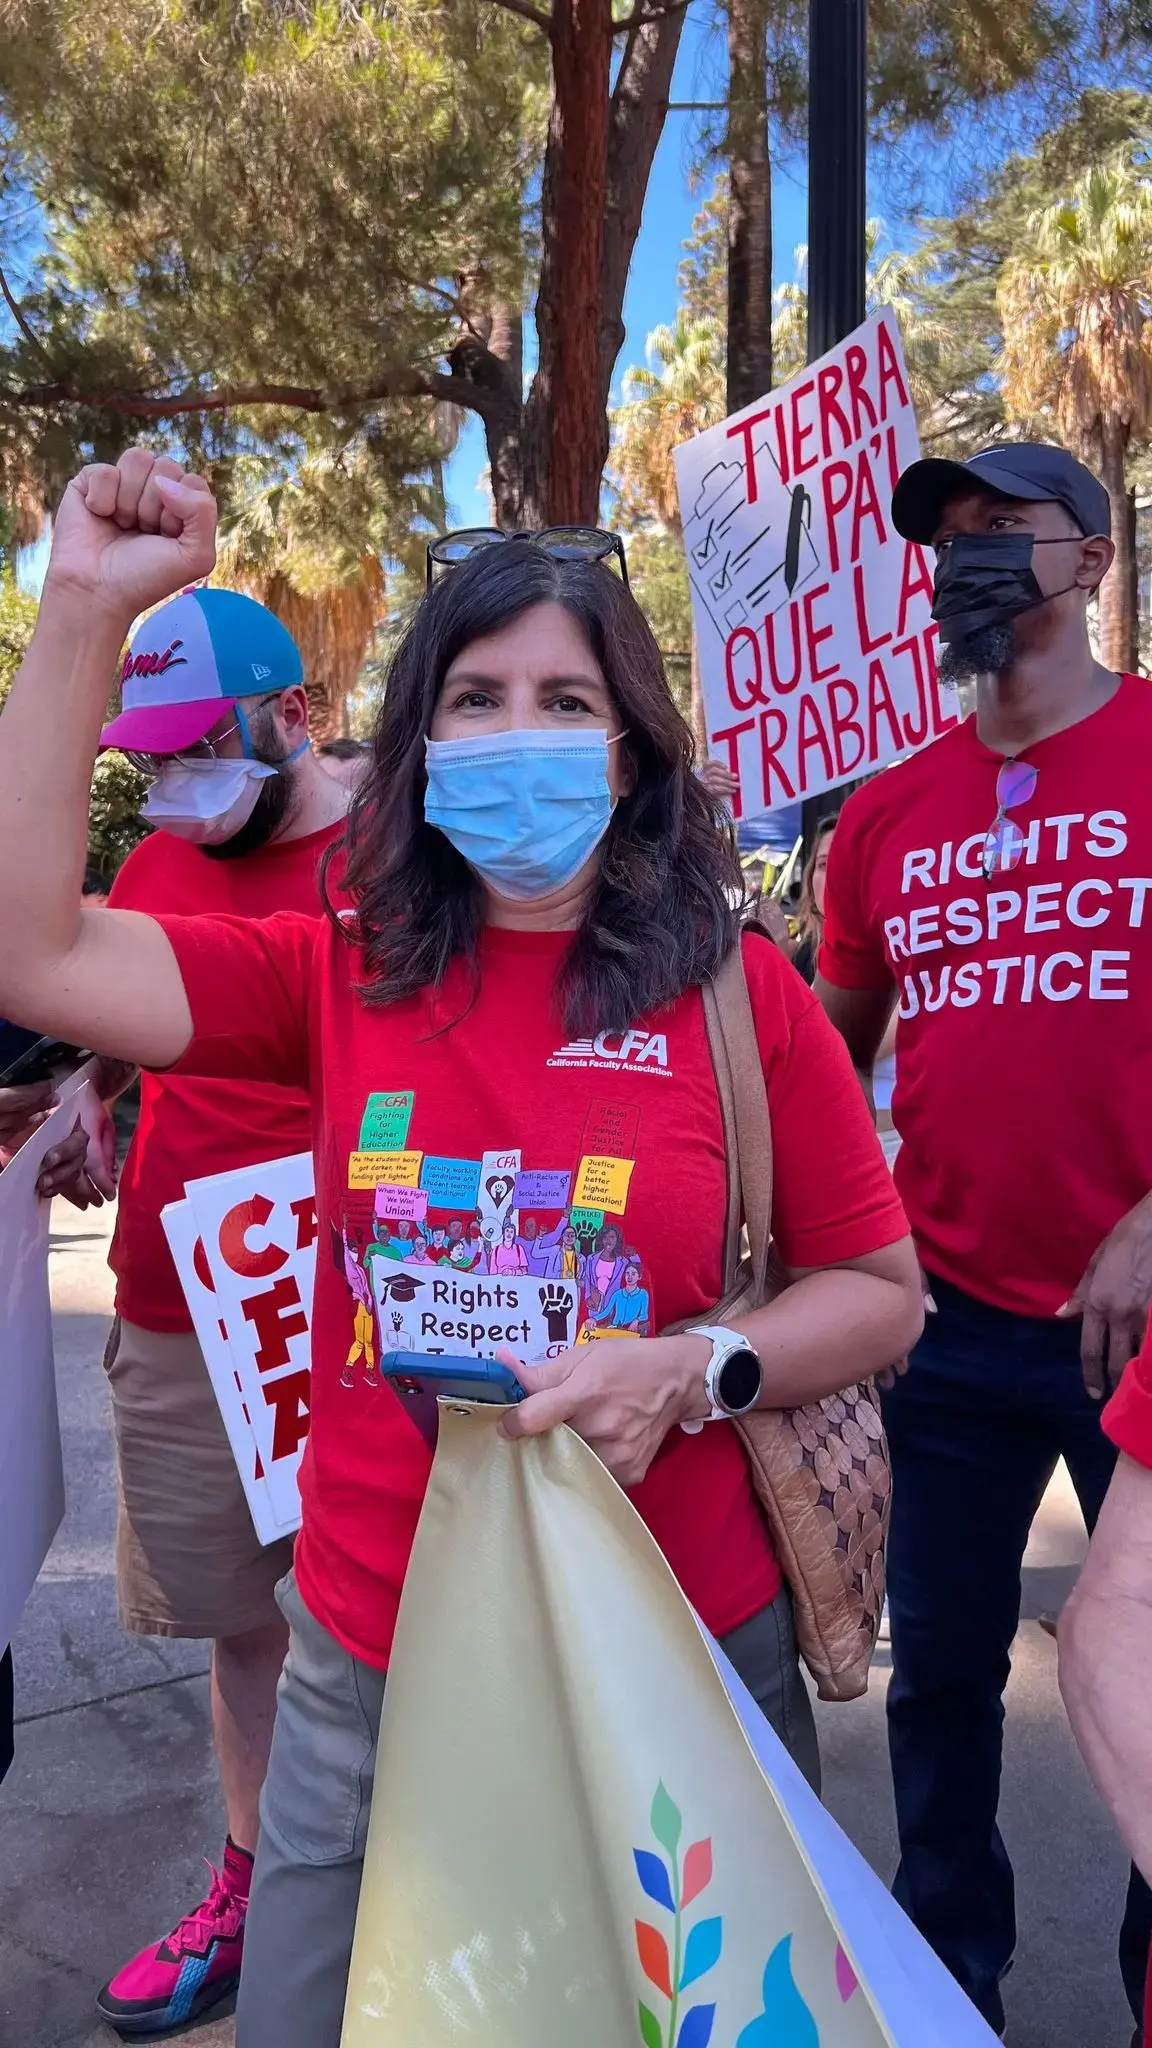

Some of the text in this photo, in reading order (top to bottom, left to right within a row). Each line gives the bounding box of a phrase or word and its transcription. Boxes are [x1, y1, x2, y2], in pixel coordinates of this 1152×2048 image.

[726, 320, 909, 504] TIERRA
[724, 540, 936, 712] QUE LA
[901, 810, 1128, 894] RIGHTS
[884, 877, 1152, 963] RESPECT
[898, 950, 1131, 1020] JUSTICE
[593, 1028, 668, 1067] CFA
[546, 1058, 673, 1078] California Faculty Association
[384, 1095, 408, 1108] CFA
[369, 1111, 405, 1121] Fighting
[379, 1120, 392, 1128] for
[369, 1131, 398, 1140] Higher
[361, 1140, 404, 1149] Education
[496, 1156, 517, 1169] CFA
[587, 1158, 616, 1169] Justice
[587, 1166, 599, 1175] for
[584, 1175, 610, 1185] better
[410, 1190, 428, 1199] Fight
[582, 1184, 609, 1194] higher
[581, 1194, 623, 1206] education!
[385, 1205, 415, 1217] Union!
[432, 1279, 519, 1314] Rights
[420, 1312, 532, 1348] Respect
[545, 1344, 569, 1359] CF
